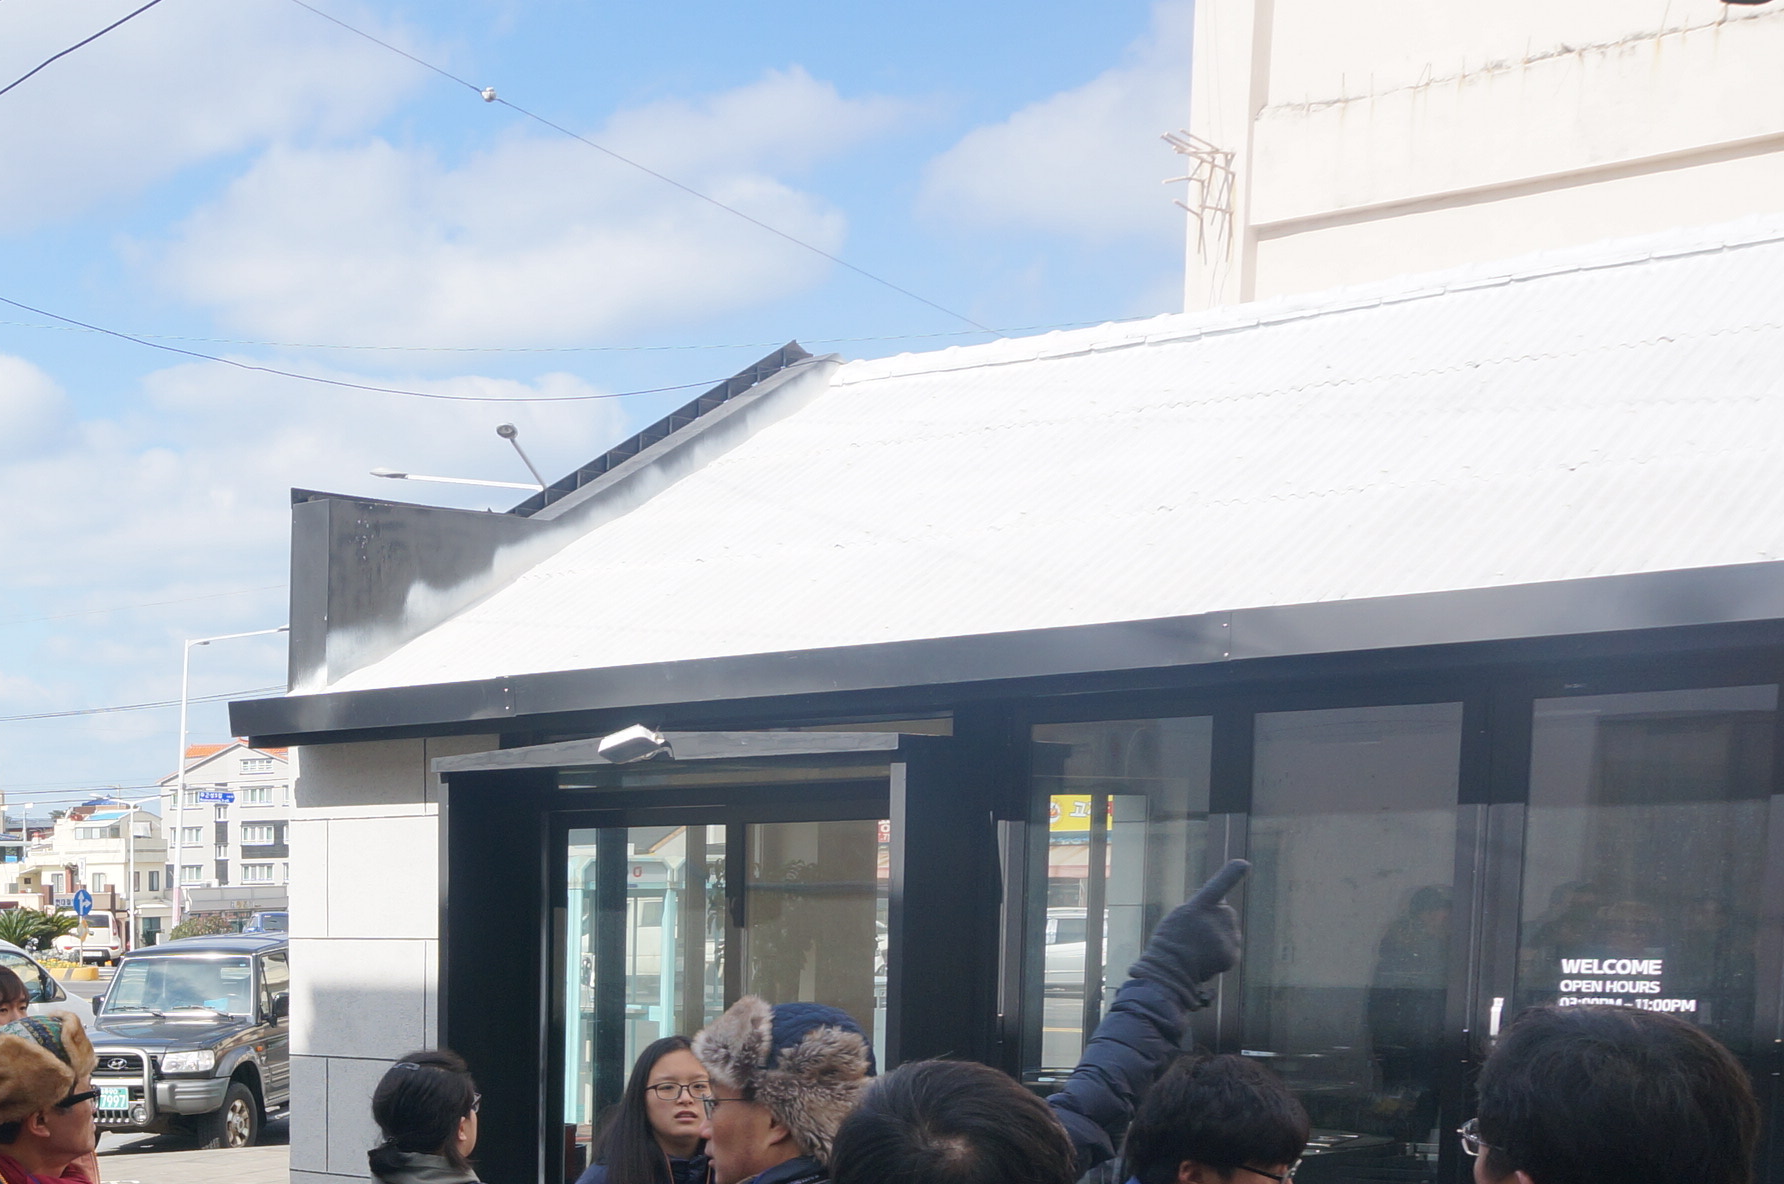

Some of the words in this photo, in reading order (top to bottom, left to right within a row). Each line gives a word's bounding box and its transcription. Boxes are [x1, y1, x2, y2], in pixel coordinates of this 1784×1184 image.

[1561, 958, 1663, 975] WELCOME
[1560, 980, 1603, 993] OPEN
[1605, 980, 1661, 994] HOURS
[1635, 999, 1696, 1012] 11:00PM
[100, 1094, 126, 1108] 7997
